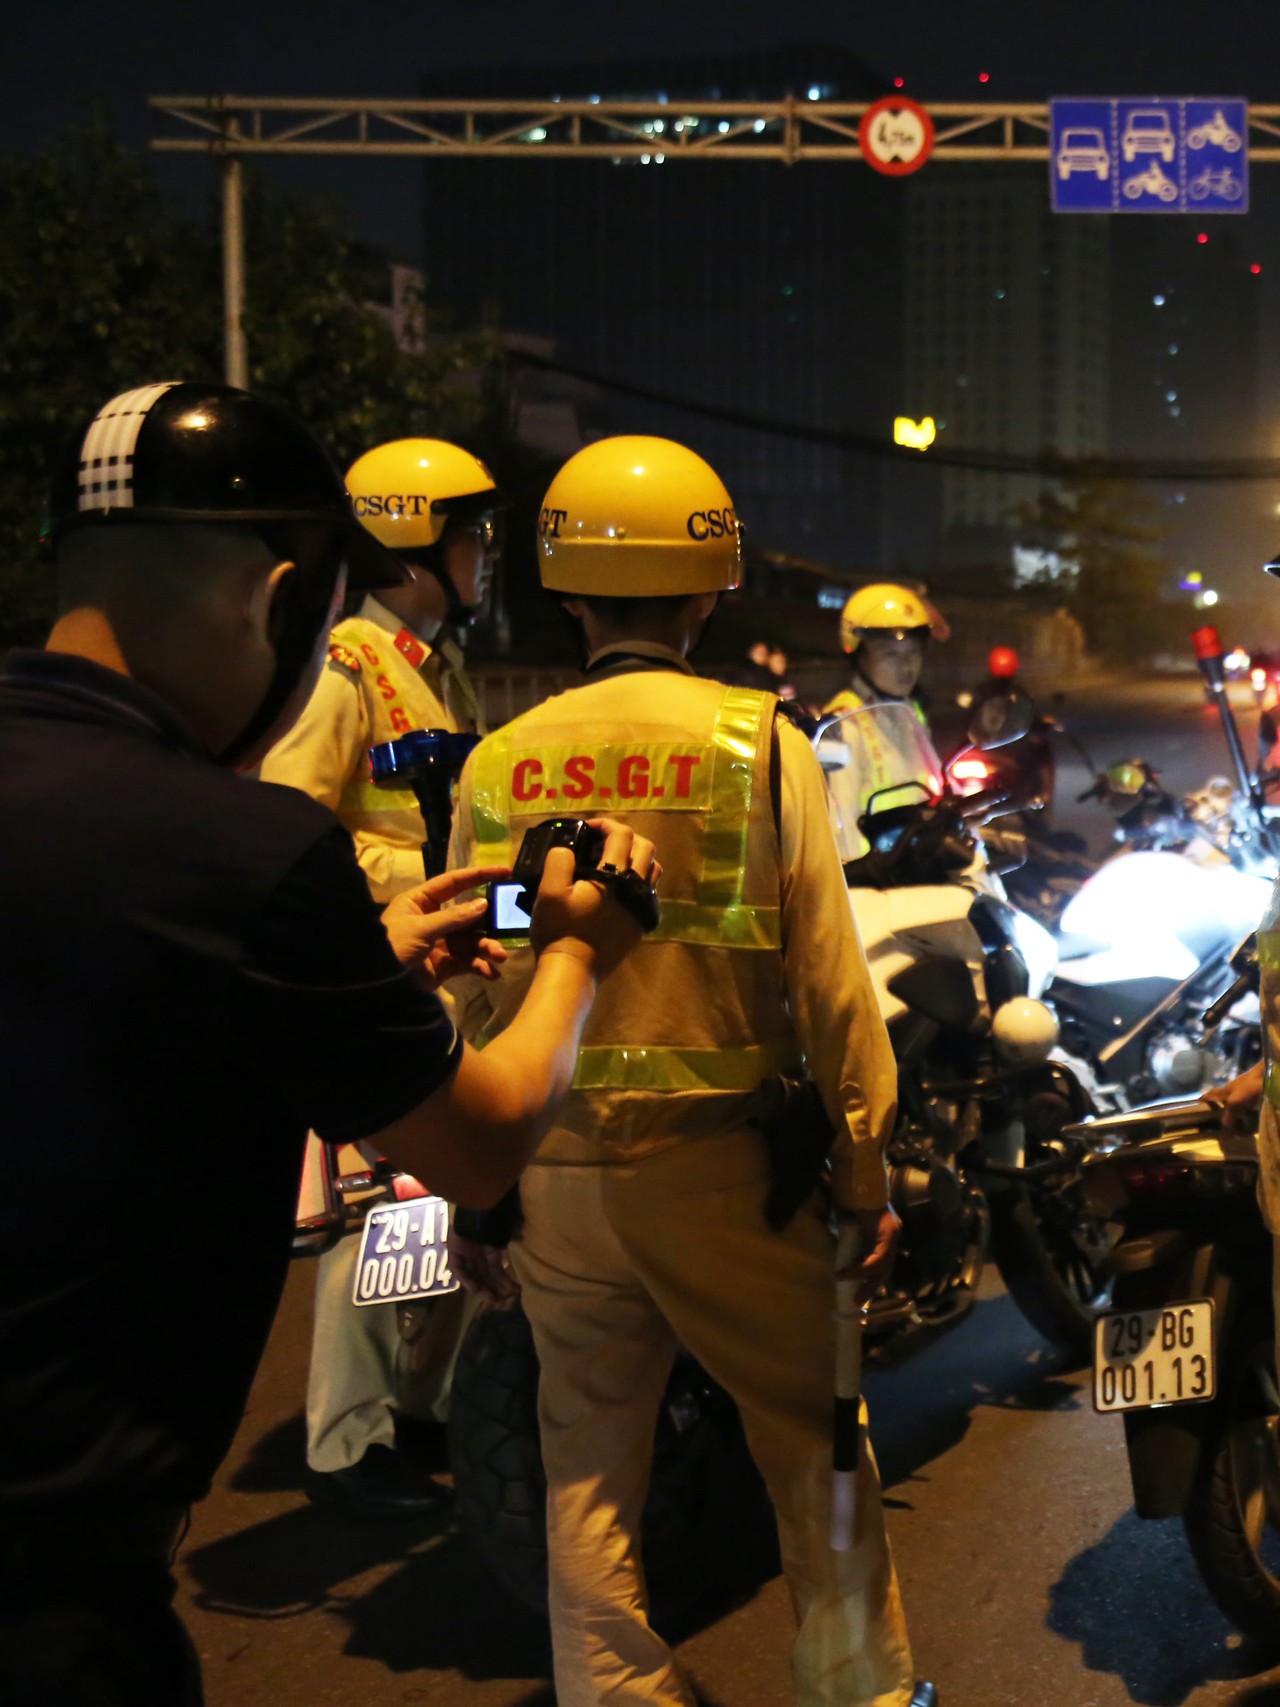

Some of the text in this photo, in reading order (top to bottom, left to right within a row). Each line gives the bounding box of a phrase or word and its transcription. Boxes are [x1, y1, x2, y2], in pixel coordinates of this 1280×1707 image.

[354, 495, 427, 517] CSGT
[512, 755, 702, 802] C.S.G.T
[360, 1248, 453, 1299] 000.04
[1111, 1309, 1194, 1358] 29-BG
[1102, 1355, 1206, 1405] 001.13
